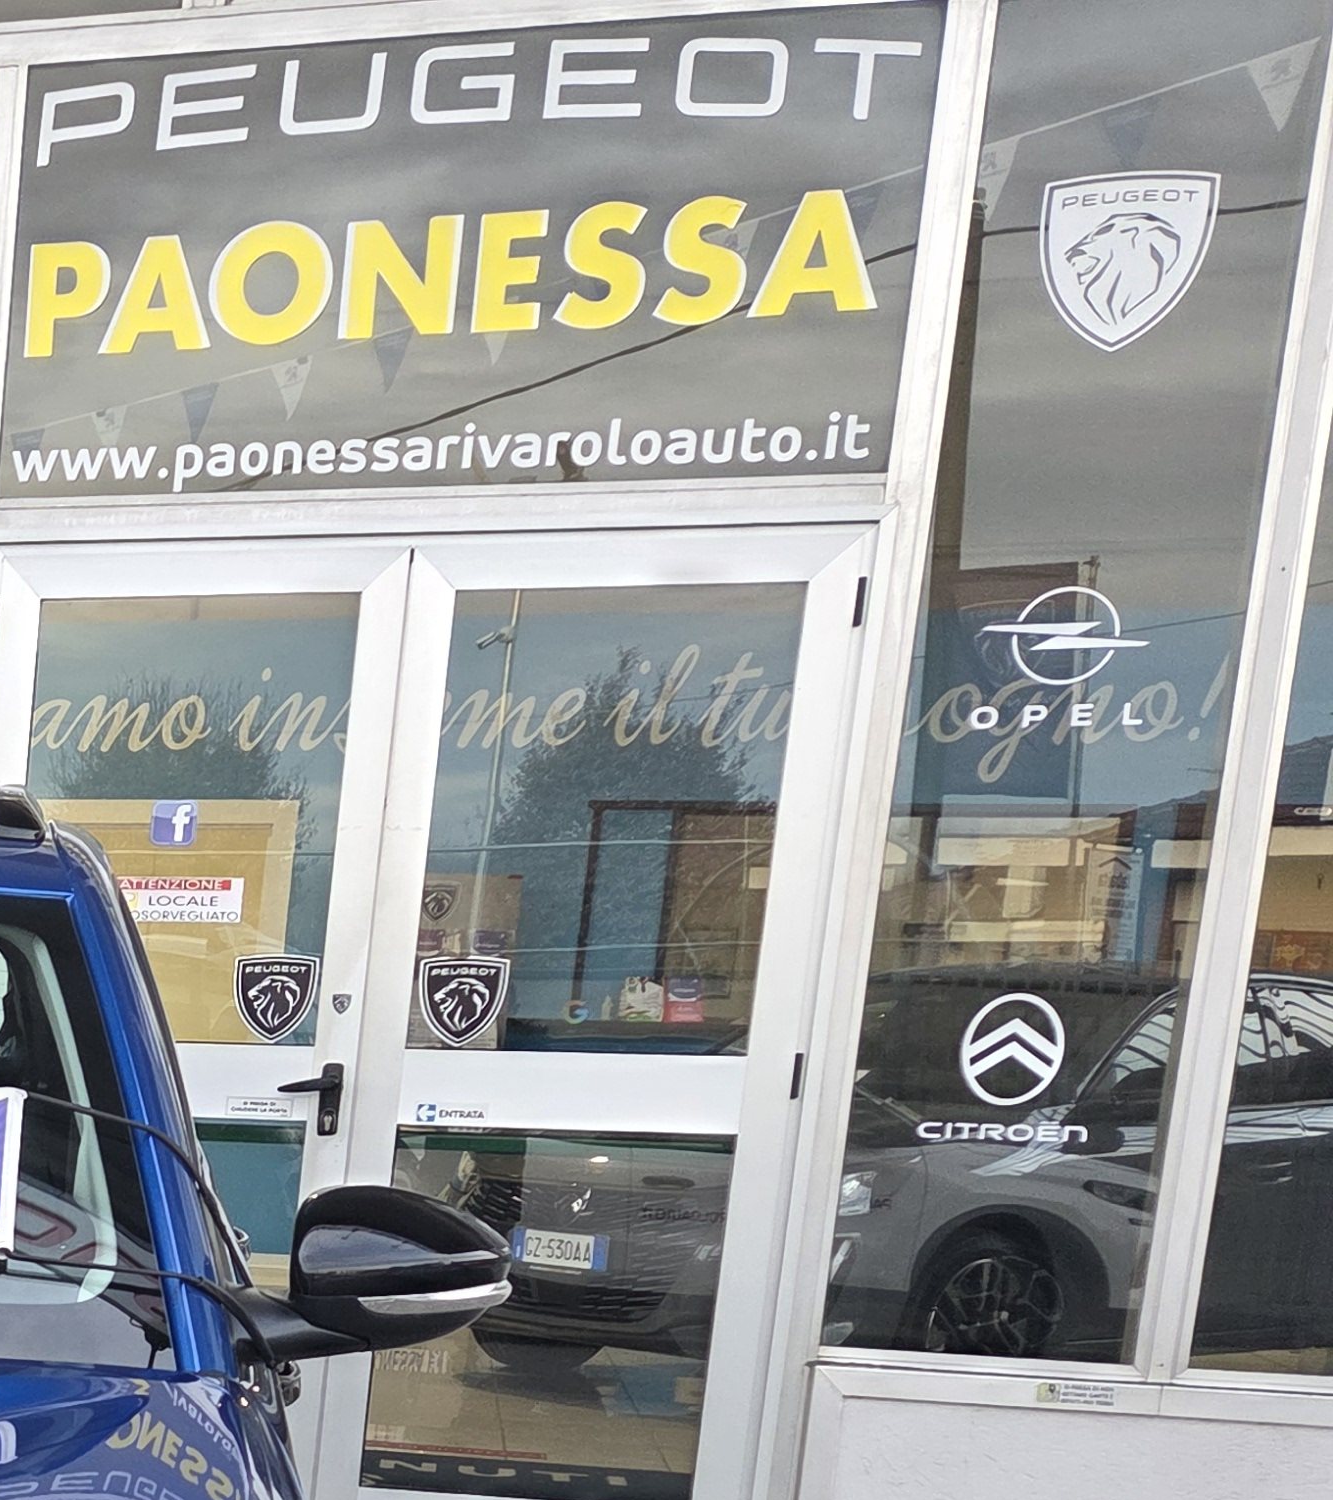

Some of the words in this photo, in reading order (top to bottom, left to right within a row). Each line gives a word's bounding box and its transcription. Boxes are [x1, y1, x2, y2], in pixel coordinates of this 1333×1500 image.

[35, 37, 923, 168] PEUGEOT
[1062, 189, 1200, 209] PEUGEOT
[22, 186, 879, 360] PAONESSA
[11, 410, 872, 493] www.paonessarivaroloauto.it
[603, 643, 701, 748] il
[903, 650, 1230, 784] ogno!
[969, 702, 1144, 730] OPEL
[119, 879, 224, 891] ATTENZIONE
[148, 895, 219, 906] LOCALE
[245, 965, 309, 974] PEUGEOT
[430, 967, 498, 977] PEUGEOT
[438, 1108, 485, 1120] ENTRATA
